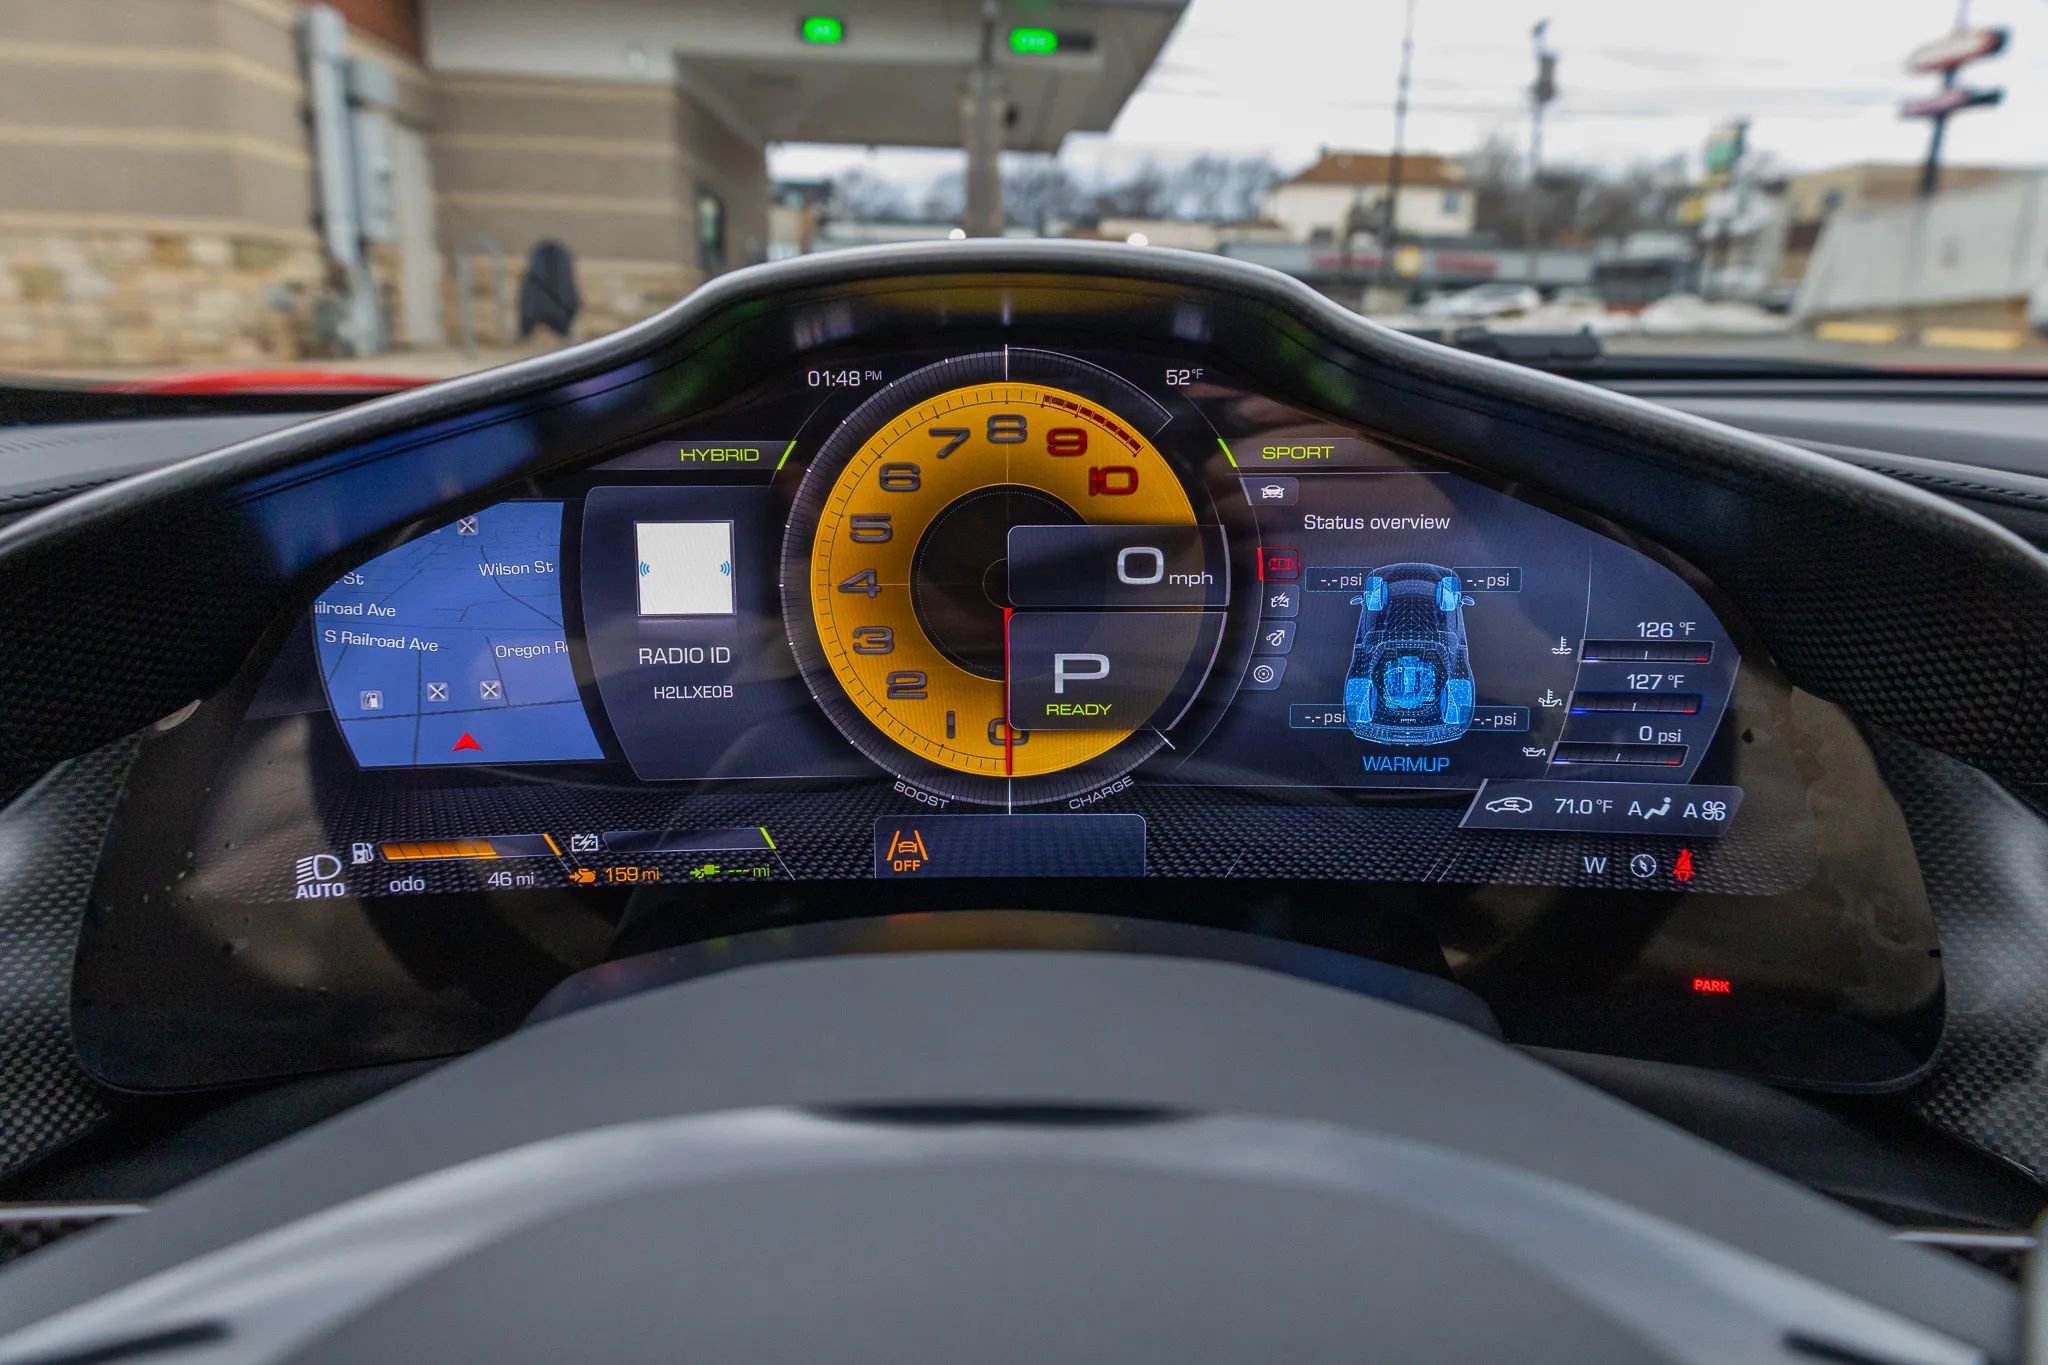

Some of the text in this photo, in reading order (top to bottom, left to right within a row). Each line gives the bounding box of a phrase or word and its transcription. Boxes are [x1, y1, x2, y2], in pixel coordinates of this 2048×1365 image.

[807, 370, 883, 388] 01:48 PM
[986, 414, 1028, 444] 8
[929, 428, 970, 459] 7
[1046, 427, 1089, 457] 9
[680, 448, 760, 463] HYBRID
[1262, 446, 1334, 461] SPORT
[879, 462, 921, 492] 6
[1089, 466, 1140, 497] 10
[849, 513, 893, 543] 5
[1304, 514, 1451, 531] Status overview
[479, 560, 554, 577] Wilson St
[1116, 546, 1214, 587] 0 mph
[343, 571, 365, 585] St
[838, 568, 882, 598] 4
[367, 603, 397, 617] Ave
[1636, 621, 1674, 638] 126
[324, 629, 439, 652] S Railroad Ave
[853, 627, 894, 654] 3
[495, 644, 551, 659] Oregon
[639, 647, 731, 664] RADIO ID
[1053, 653, 1110, 694] P
[1626, 673, 1663, 690] 127
[886, 672, 928, 699] 2
[1045, 703, 1112, 717] READY
[946, 710, 956, 739] 1
[1639, 725, 1682, 744] 0 psi
[1362, 756, 1450, 773] WARMUP
[893, 780, 949, 810] BOOST
[1068, 775, 1134, 810] CHARGE
[1554, 798, 1593, 815] 71.0
[1627, 801, 1643, 817] A
[1682, 803, 1699, 819] A
[753, 864, 771, 877] mi
[893, 860, 921, 872] OFF
[1584, 856, 1607, 874] W
[487, 872, 536, 888] 46 mi
[604, 866, 661, 883] 159 mi
[296, 883, 345, 899] AUTO
[389, 876, 424, 892] odo
[1694, 979, 1730, 993] PARK
